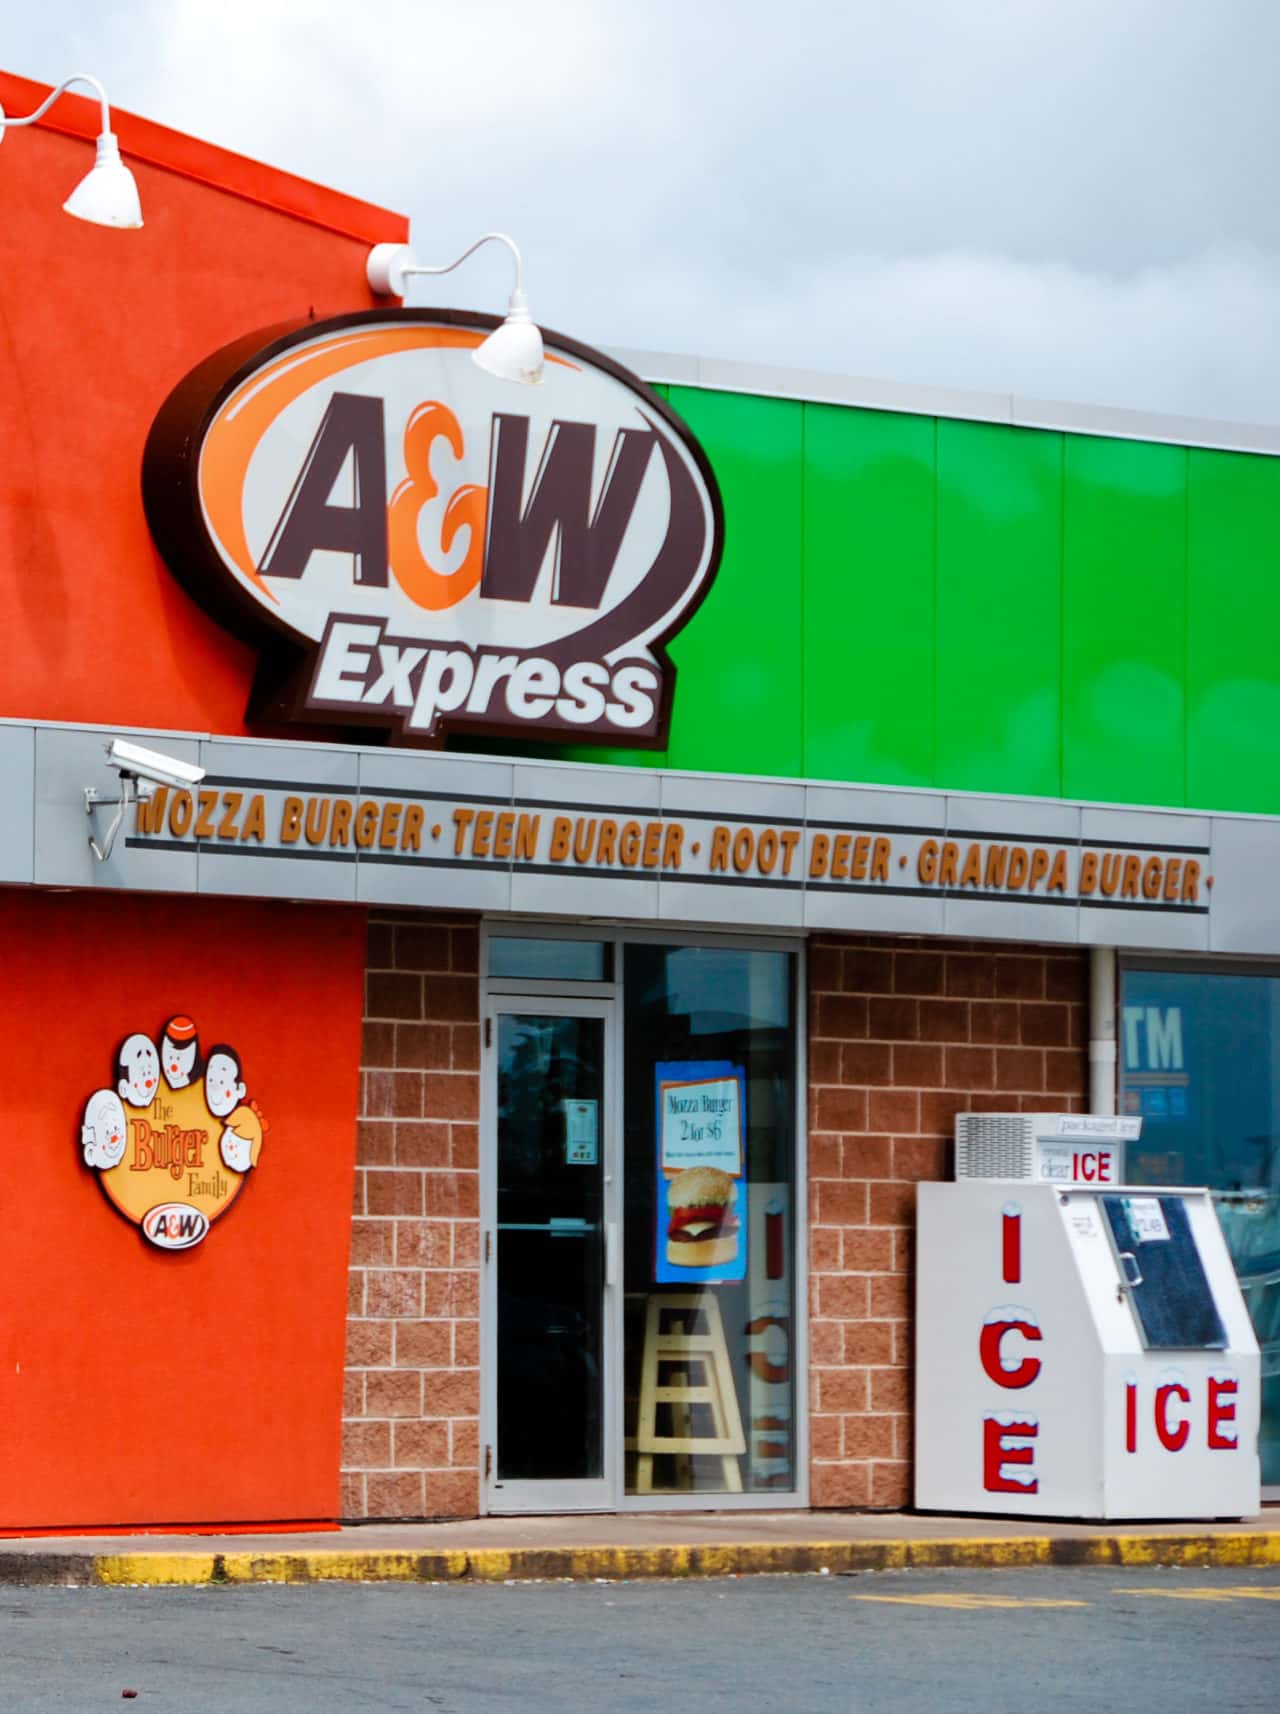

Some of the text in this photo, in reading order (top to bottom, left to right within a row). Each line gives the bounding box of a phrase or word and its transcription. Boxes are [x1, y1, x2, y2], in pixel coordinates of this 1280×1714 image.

[256, 391, 655, 611] A&W
[313, 621, 658, 729] Express
[137, 787, 1201, 900] MOZZA BURGER TEEN BURGER ROOT BEER GRANDPA BURGER
[1123, 1006, 1184, 1069] TM
[153, 1098, 174, 1121] The
[668, 1095, 699, 1114] Mozza
[680, 1119, 689, 1141] 2
[129, 1118, 209, 1181] Burger
[1072, 1151, 1113, 1182] ICE
[186, 1171, 228, 1200] Family
[154, 1214, 201, 1240] A&W
[979, 1205, 1043, 1495] ICE
[1125, 1374, 1239, 1454] ICE
